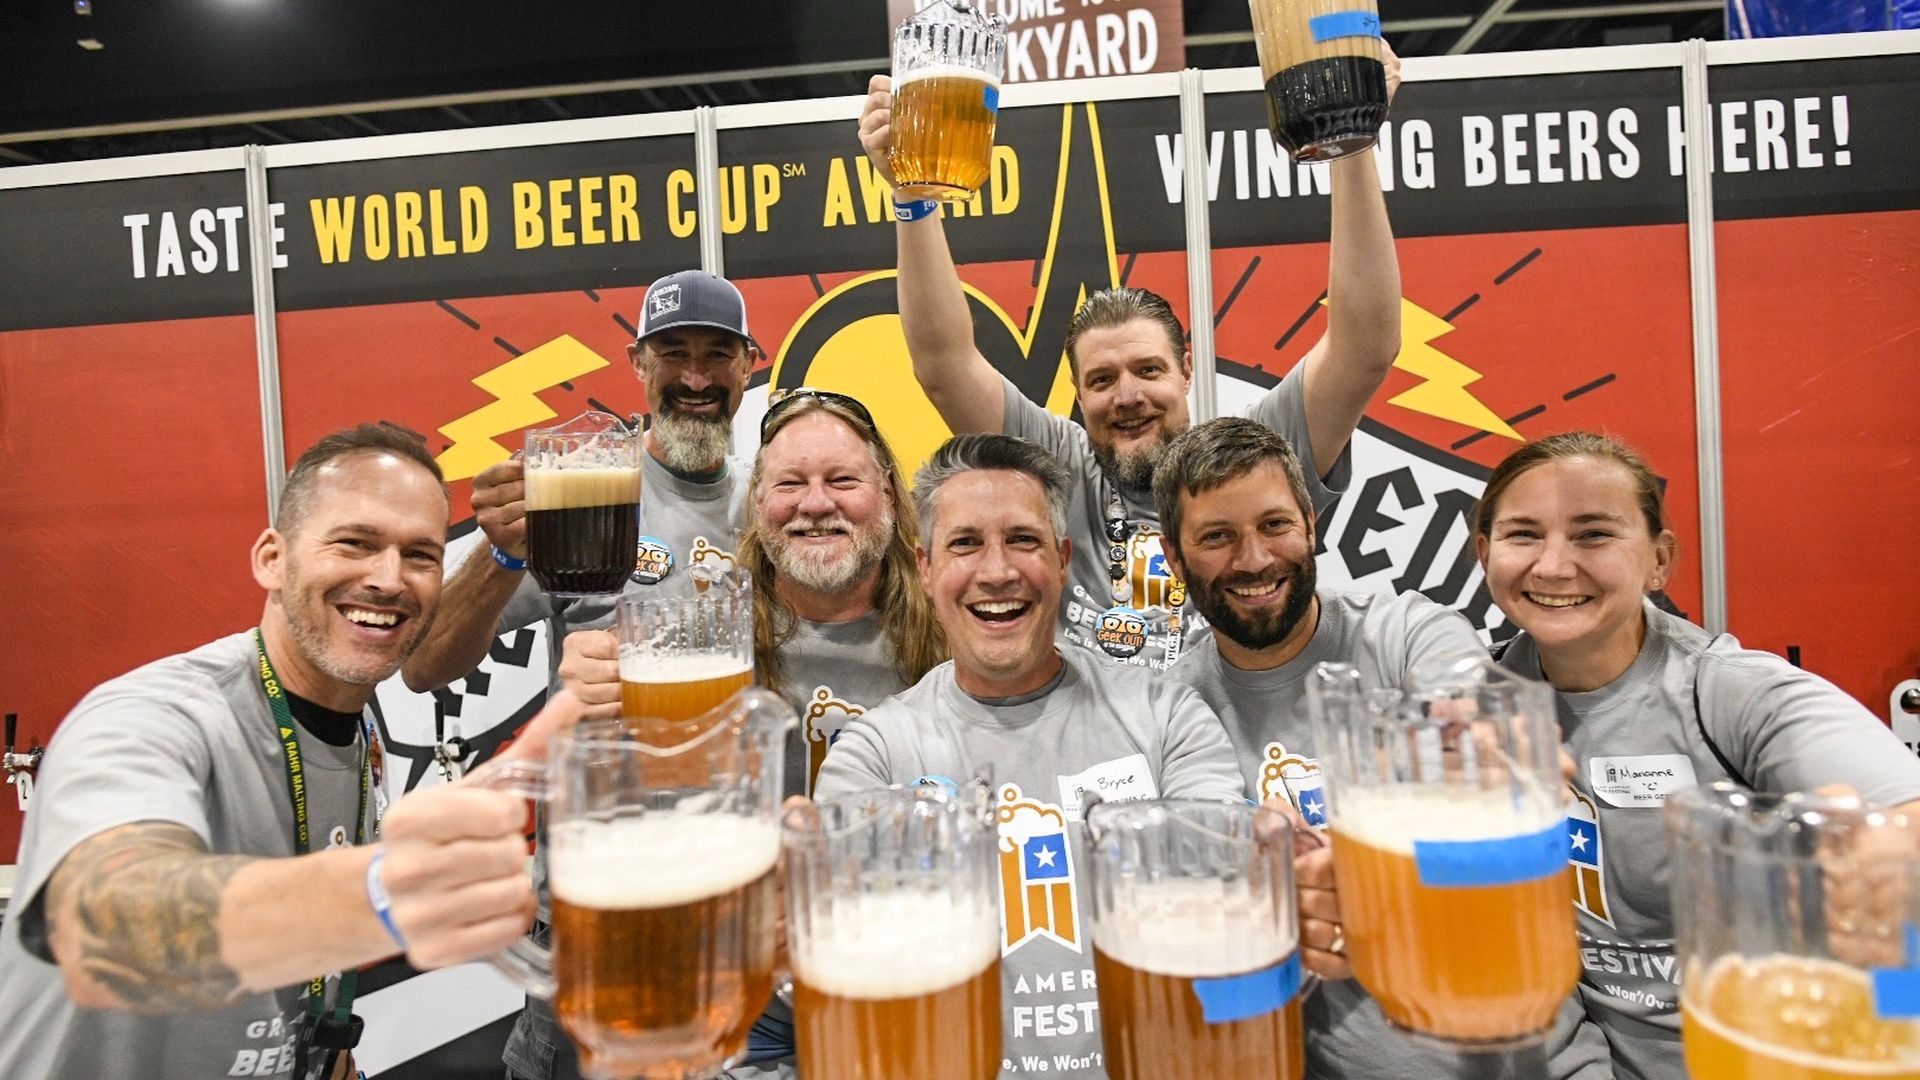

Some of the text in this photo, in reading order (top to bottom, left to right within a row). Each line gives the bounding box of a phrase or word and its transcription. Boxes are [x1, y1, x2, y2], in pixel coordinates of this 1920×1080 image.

[1462, 107, 1640, 187] BEERS
[1667, 95, 1851, 176] HERE!
[123, 202, 289, 279] TASTE
[310, 185, 489, 264] WORLD
[512, 174, 641, 250] BEER
[285, 741, 300, 773] RAHR
[293, 774, 306, 822] MALTING
[1096, 774, 1134, 790] Bryce
[1021, 1055, 1049, 1072] We
[1053, 1051, 1103, 1072] Won't
